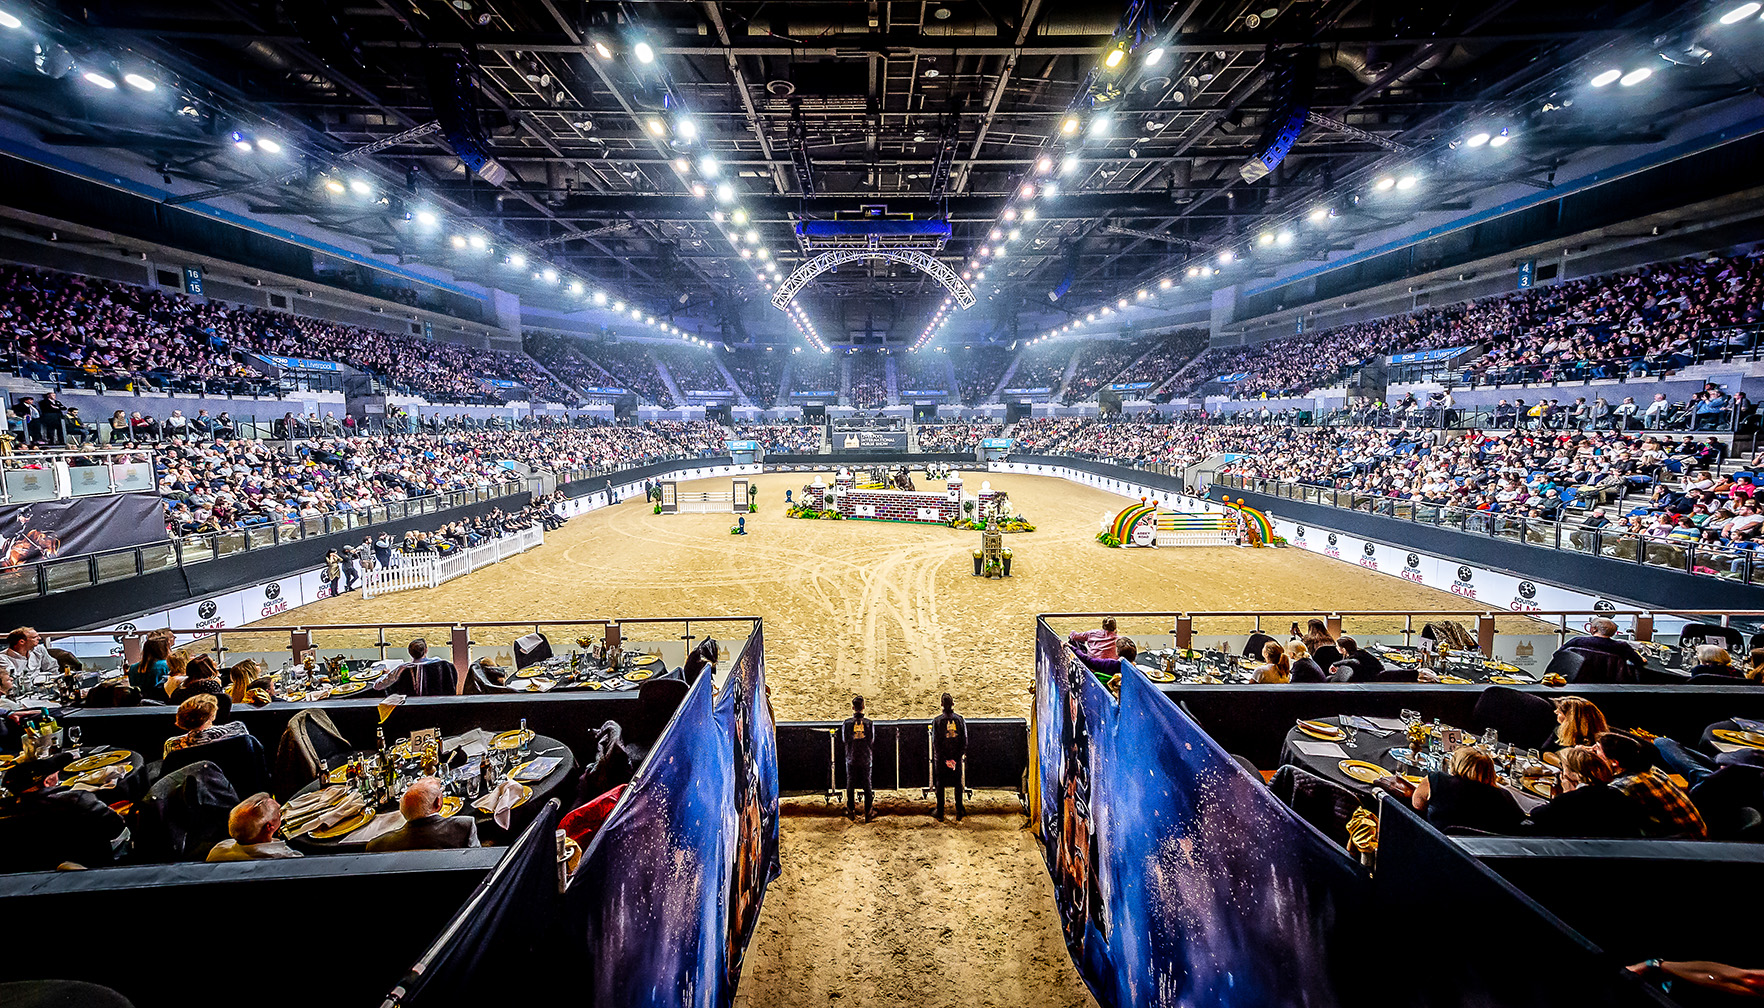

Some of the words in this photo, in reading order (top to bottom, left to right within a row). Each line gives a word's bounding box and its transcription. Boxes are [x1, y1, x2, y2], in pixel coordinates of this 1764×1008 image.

[1522, 263, 1529, 273] 4
[188, 270, 199, 279] 16
[1521, 276, 1528, 286] 3
[190, 284, 201, 293] 15
[306, 361, 332, 369] Liverpool
[1359, 558, 1378, 570] GLME
[1401, 570, 1423, 583] GLME
[1454, 580, 1474, 589] EQUITOP
[1450, 584, 1477, 599] GLME
[264, 597, 284, 607] EQUITOP
[1514, 596, 1539, 607] EQUITOP
[261, 601, 287, 617] GLME
[196, 616, 222, 628] EQUITOP
[1449, 733, 1456, 743] 6
